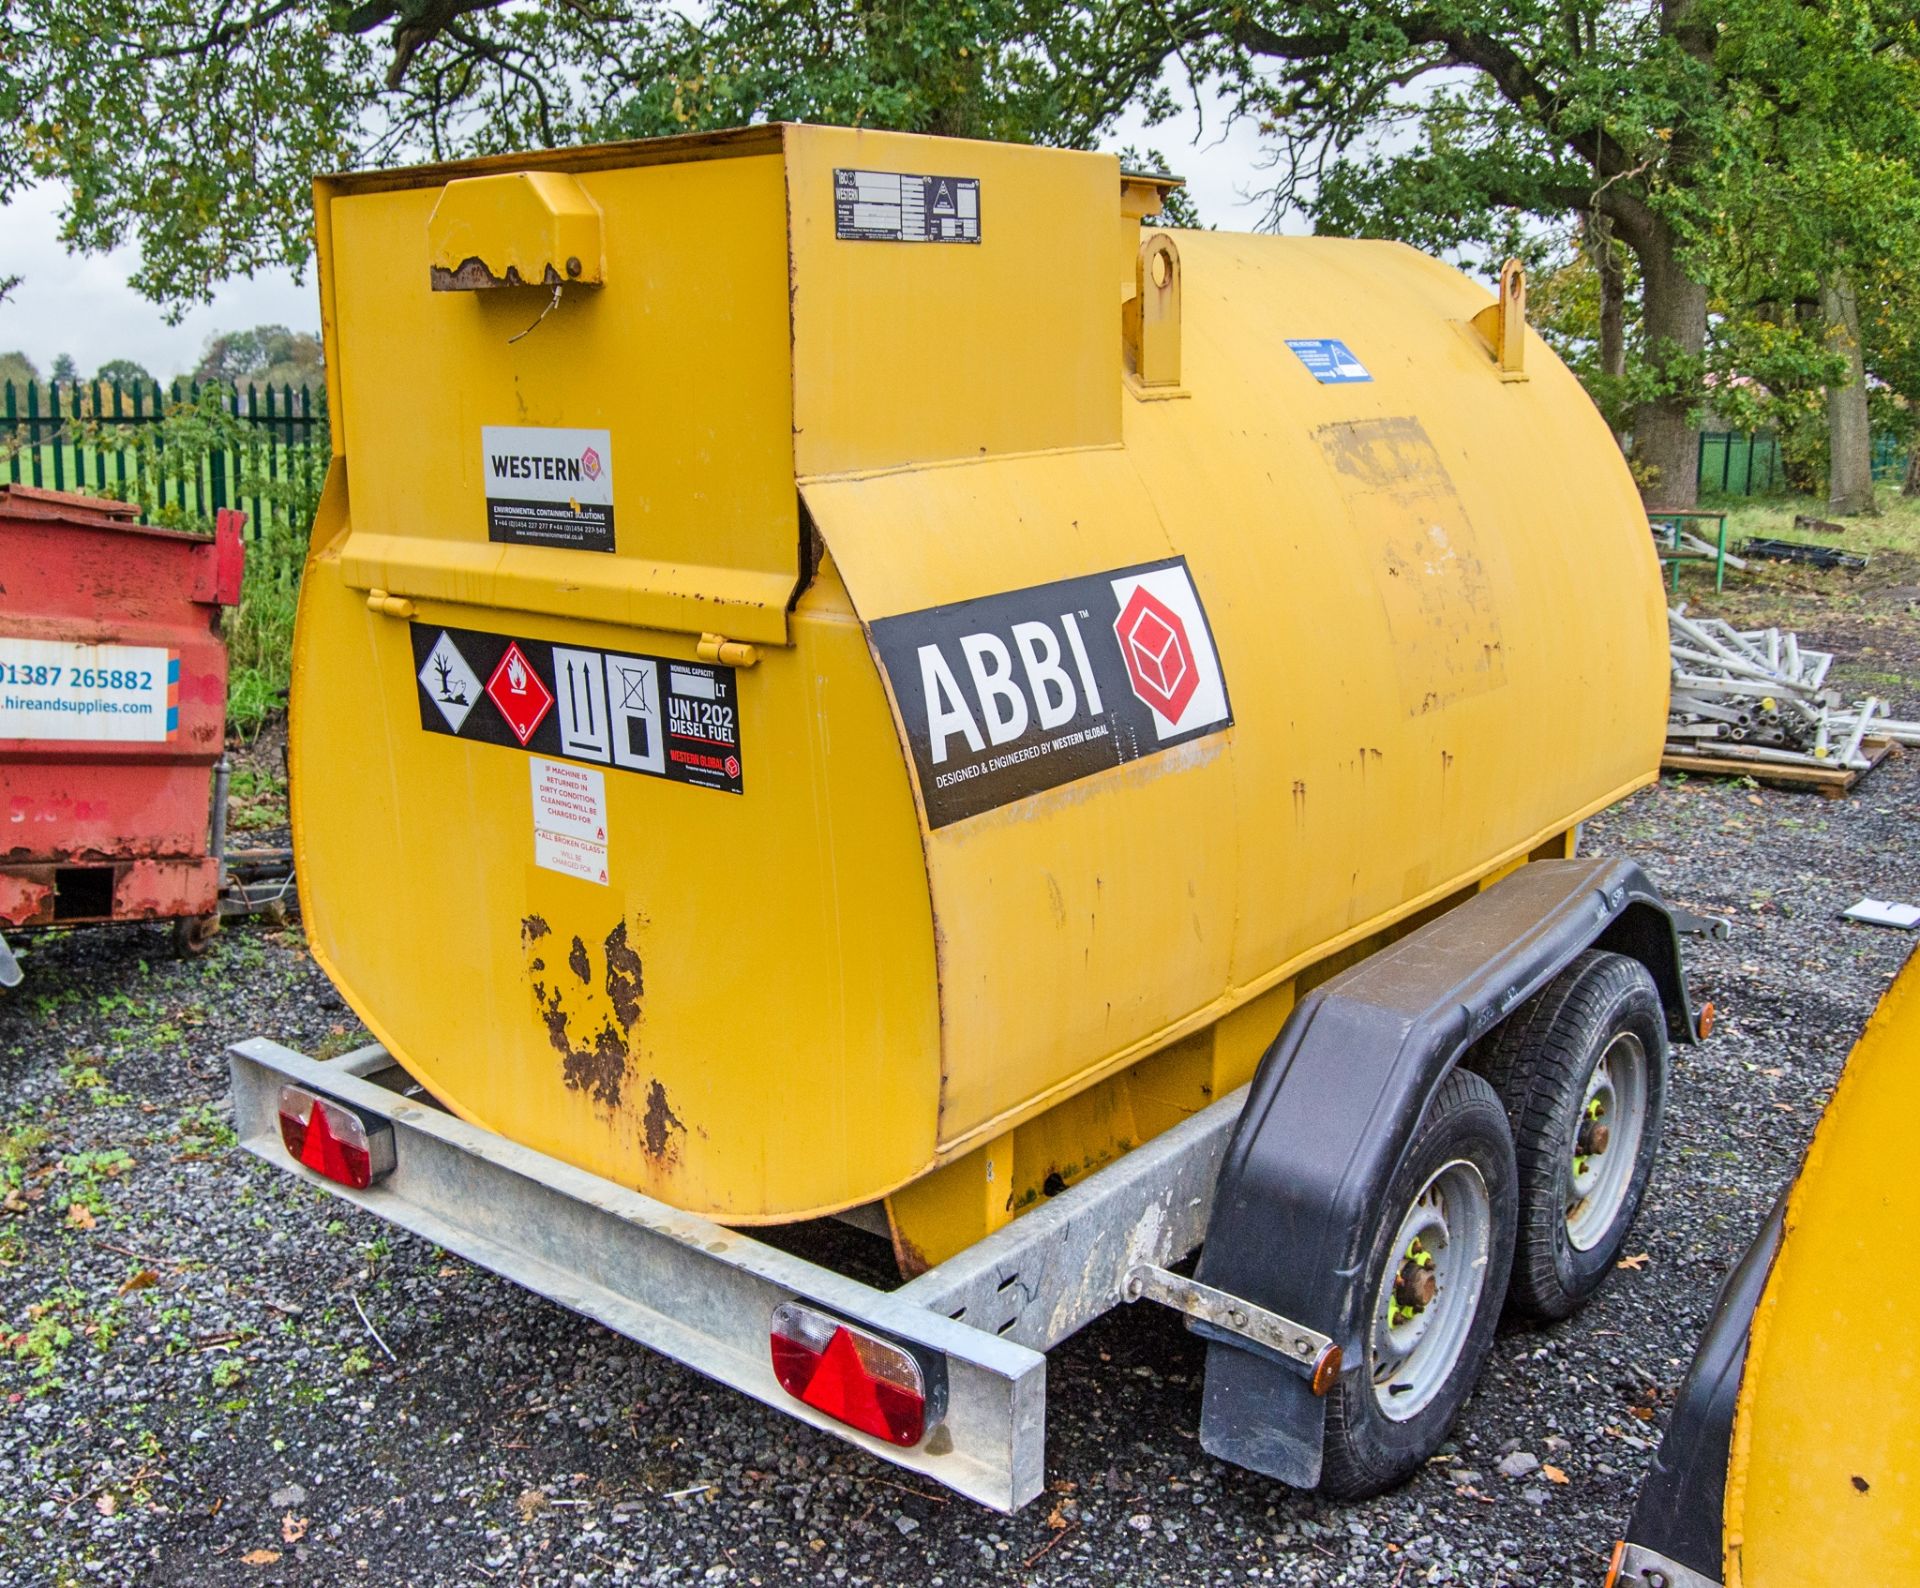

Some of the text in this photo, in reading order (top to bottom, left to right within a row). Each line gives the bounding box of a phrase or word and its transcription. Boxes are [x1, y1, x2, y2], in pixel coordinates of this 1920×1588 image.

[492, 455, 580, 482] WESTERN
[494, 506, 605, 521] ENVIRONMENTAL CONTAINMENT SOLUTIONS
[70, 668, 153, 690] 265882
[670, 665, 714, 678] NOMINAL CAPACITY
[715, 683, 727, 698] LT
[917, 612, 1104, 765] ABBI
[668, 698, 734, 729] UN1202
[519, 725, 526, 736] 3
[670, 719, 735, 743] DIESEL FUEL
[670, 750, 724, 770] WESTERN GLOBAL
[936, 724, 1109, 789] DESIGNED & ENGINEERED BY WESTERN GLOBAL
[552, 767, 580, 779] MACHINE
[539, 785, 557, 794] DIRTY
[546, 776, 579, 789] RETURNED
[541, 796, 572, 808] CLEANING
[572, 803, 588, 813] WILL
[547, 808, 577, 820] CHARGED
[542, 832, 601, 854] ALL BROKEN GLASS
[560, 850, 582, 862] WILL BE
[552, 857, 592, 873] CHARGED FOR
